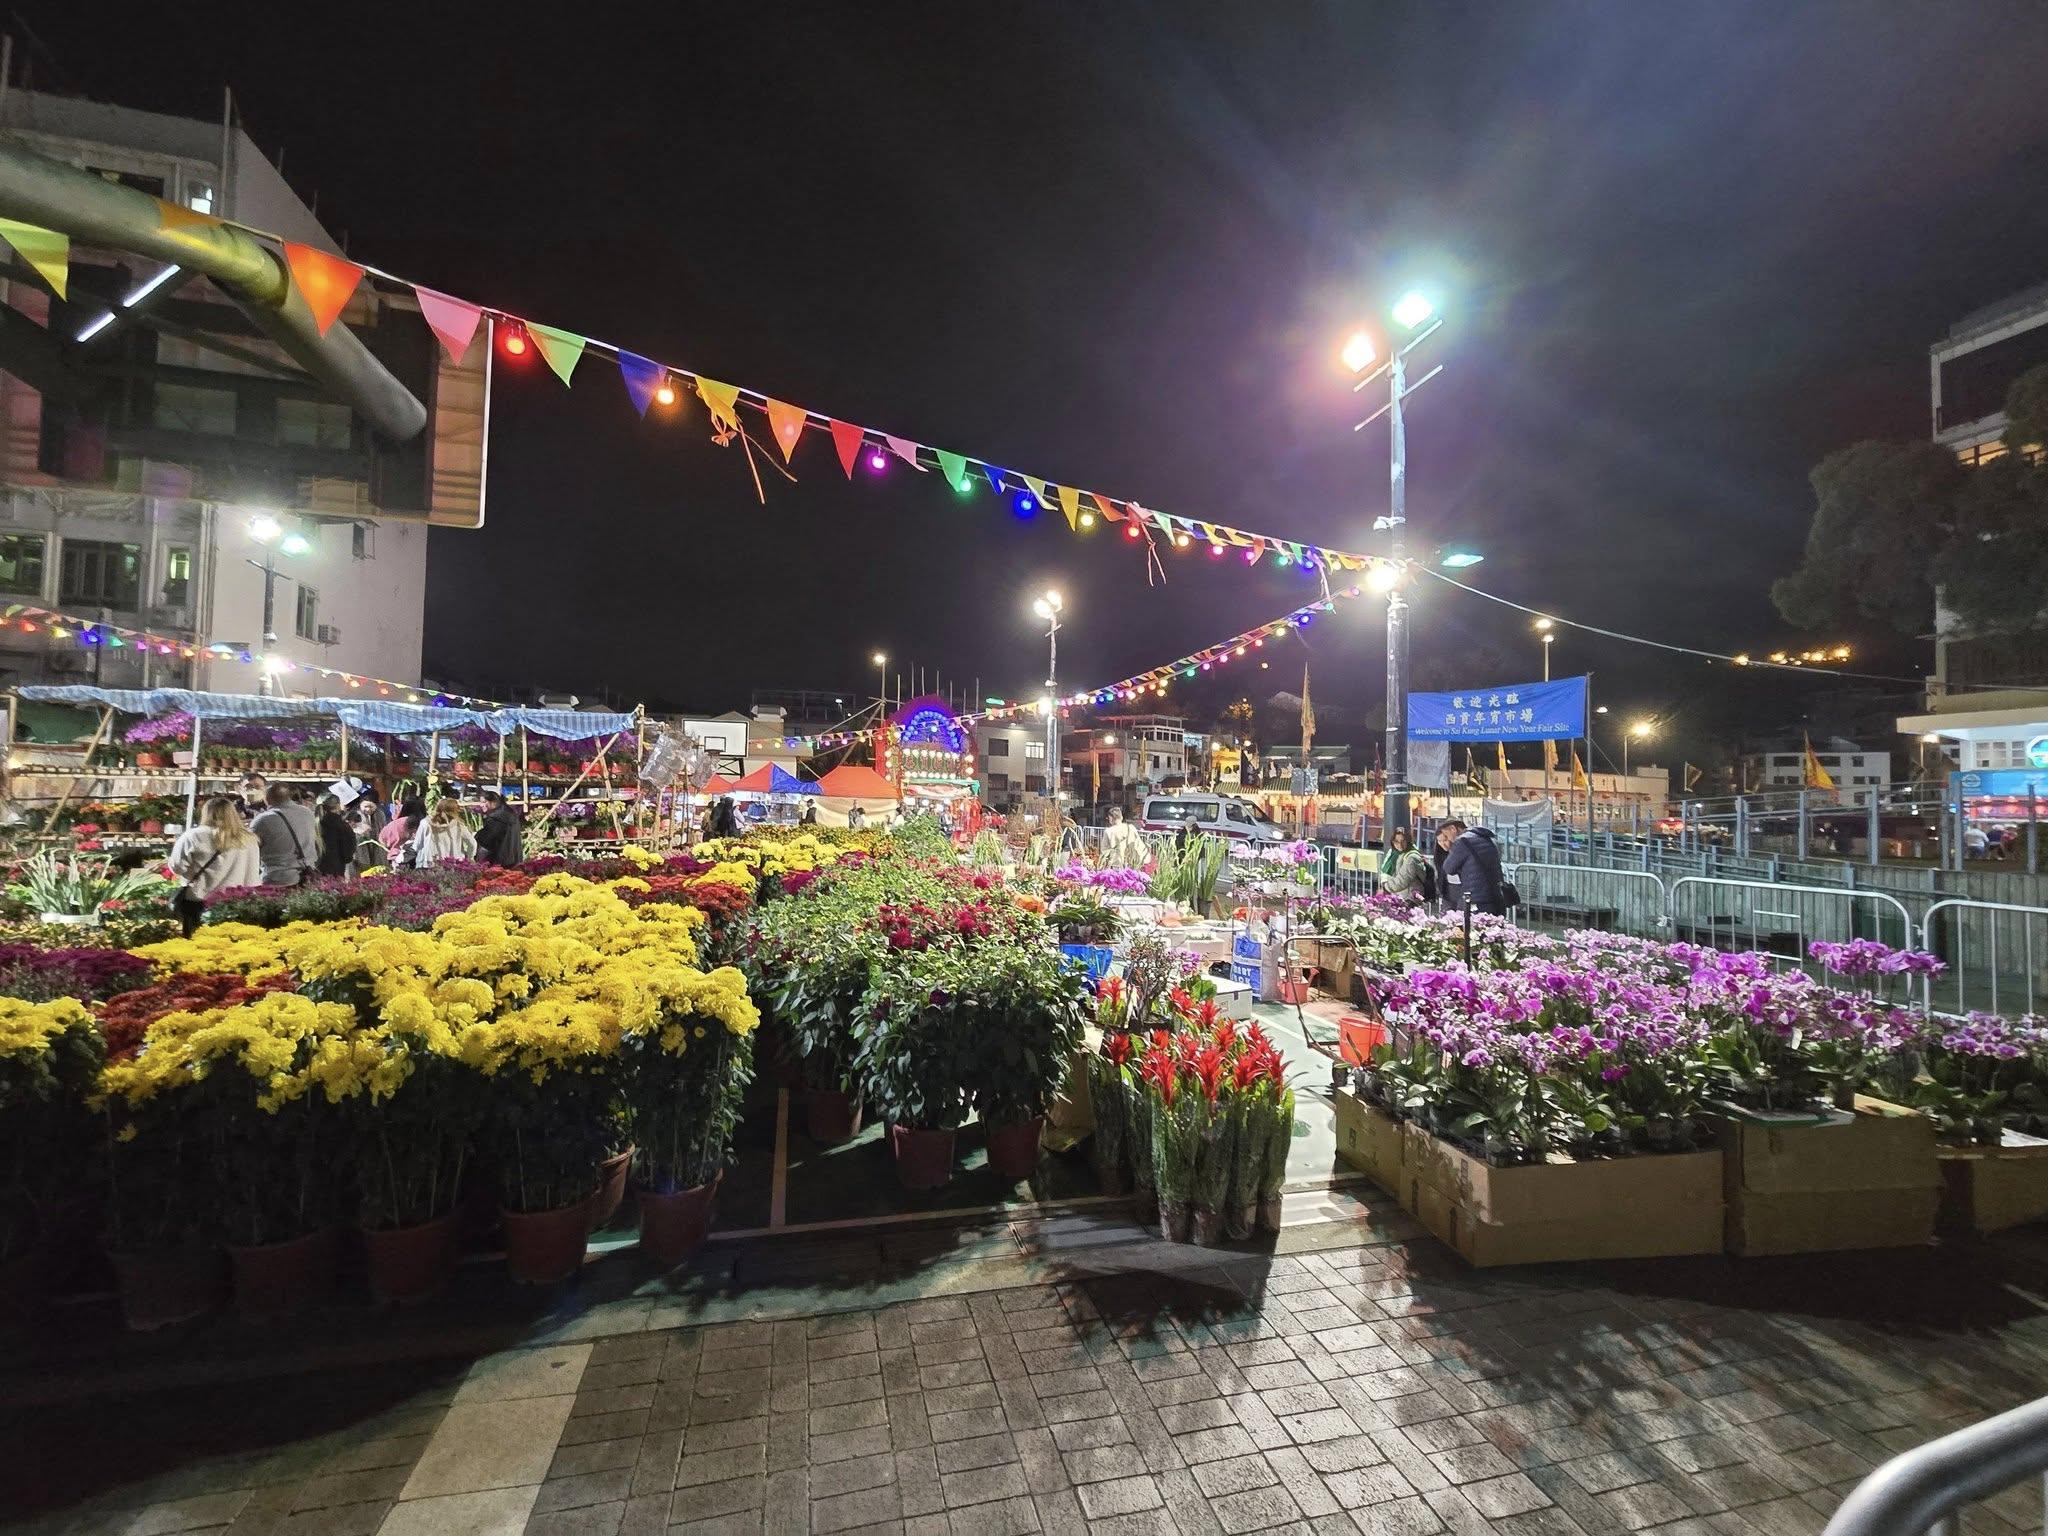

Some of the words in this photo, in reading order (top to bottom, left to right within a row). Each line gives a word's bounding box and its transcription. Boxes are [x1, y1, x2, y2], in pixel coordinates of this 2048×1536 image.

[1453, 692, 1520, 709] 歡迎光臨
[1445, 708, 1534, 726] 西貢年宵市場
[1451, 727, 1461, 735] Sai
[1462, 727, 1479, 736] Kung
[1502, 726, 1518, 734] New
[1520, 724, 1536, 733] Year
[1537, 724, 1553, 732] Fair
[1554, 722, 1570, 732] Site
